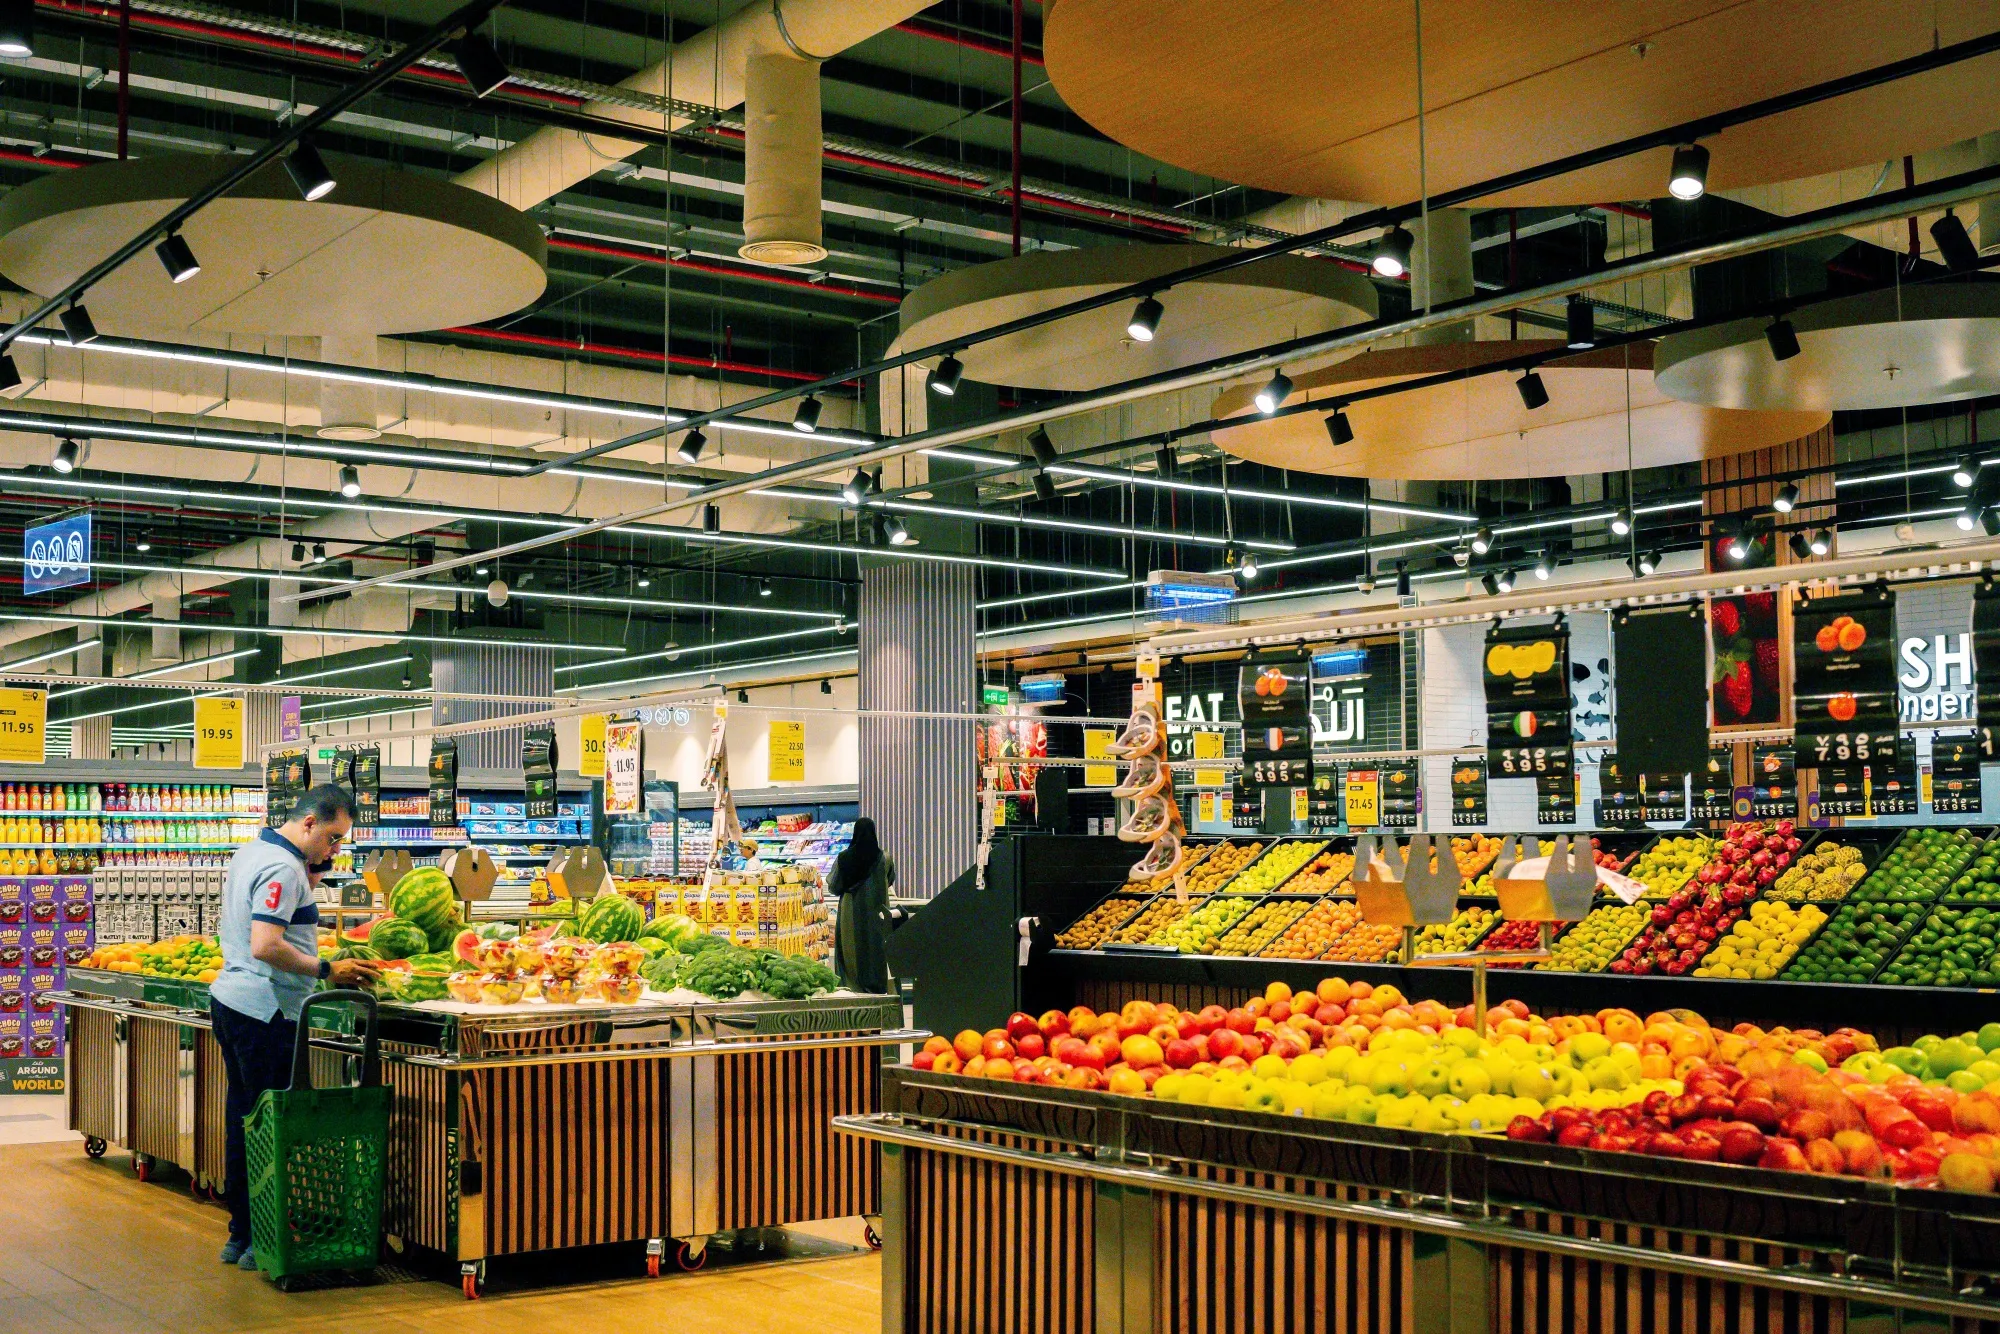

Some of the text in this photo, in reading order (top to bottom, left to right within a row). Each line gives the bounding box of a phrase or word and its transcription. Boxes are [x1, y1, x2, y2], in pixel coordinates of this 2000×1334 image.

[1899, 693, 1970, 721] nger
[2, 722, 34, 734] 11.95
[202, 728, 233, 740] 19.95
[788, 742, 804, 750] 22.50
[1814, 746, 1870, 761] 7.95
[788, 758, 802, 766] 14.95
[1502, 760, 1546, 772] 9.95
[1254, 771, 1288, 782] 9.95
[1349, 798, 1372, 810] 21.45
[31, 884, 54, 893] CHOCO
[64, 884, 87, 893] CHOCO
[265, 882, 282, 910] 3
[31, 930, 54, 938] CHOCO
[64, 930, 87, 938] CHOCO
[32, 974, 54, 983] CHOCO
[31, 1019, 54, 1027] CHOCO
[12, 1080, 64, 1090] WORLD
